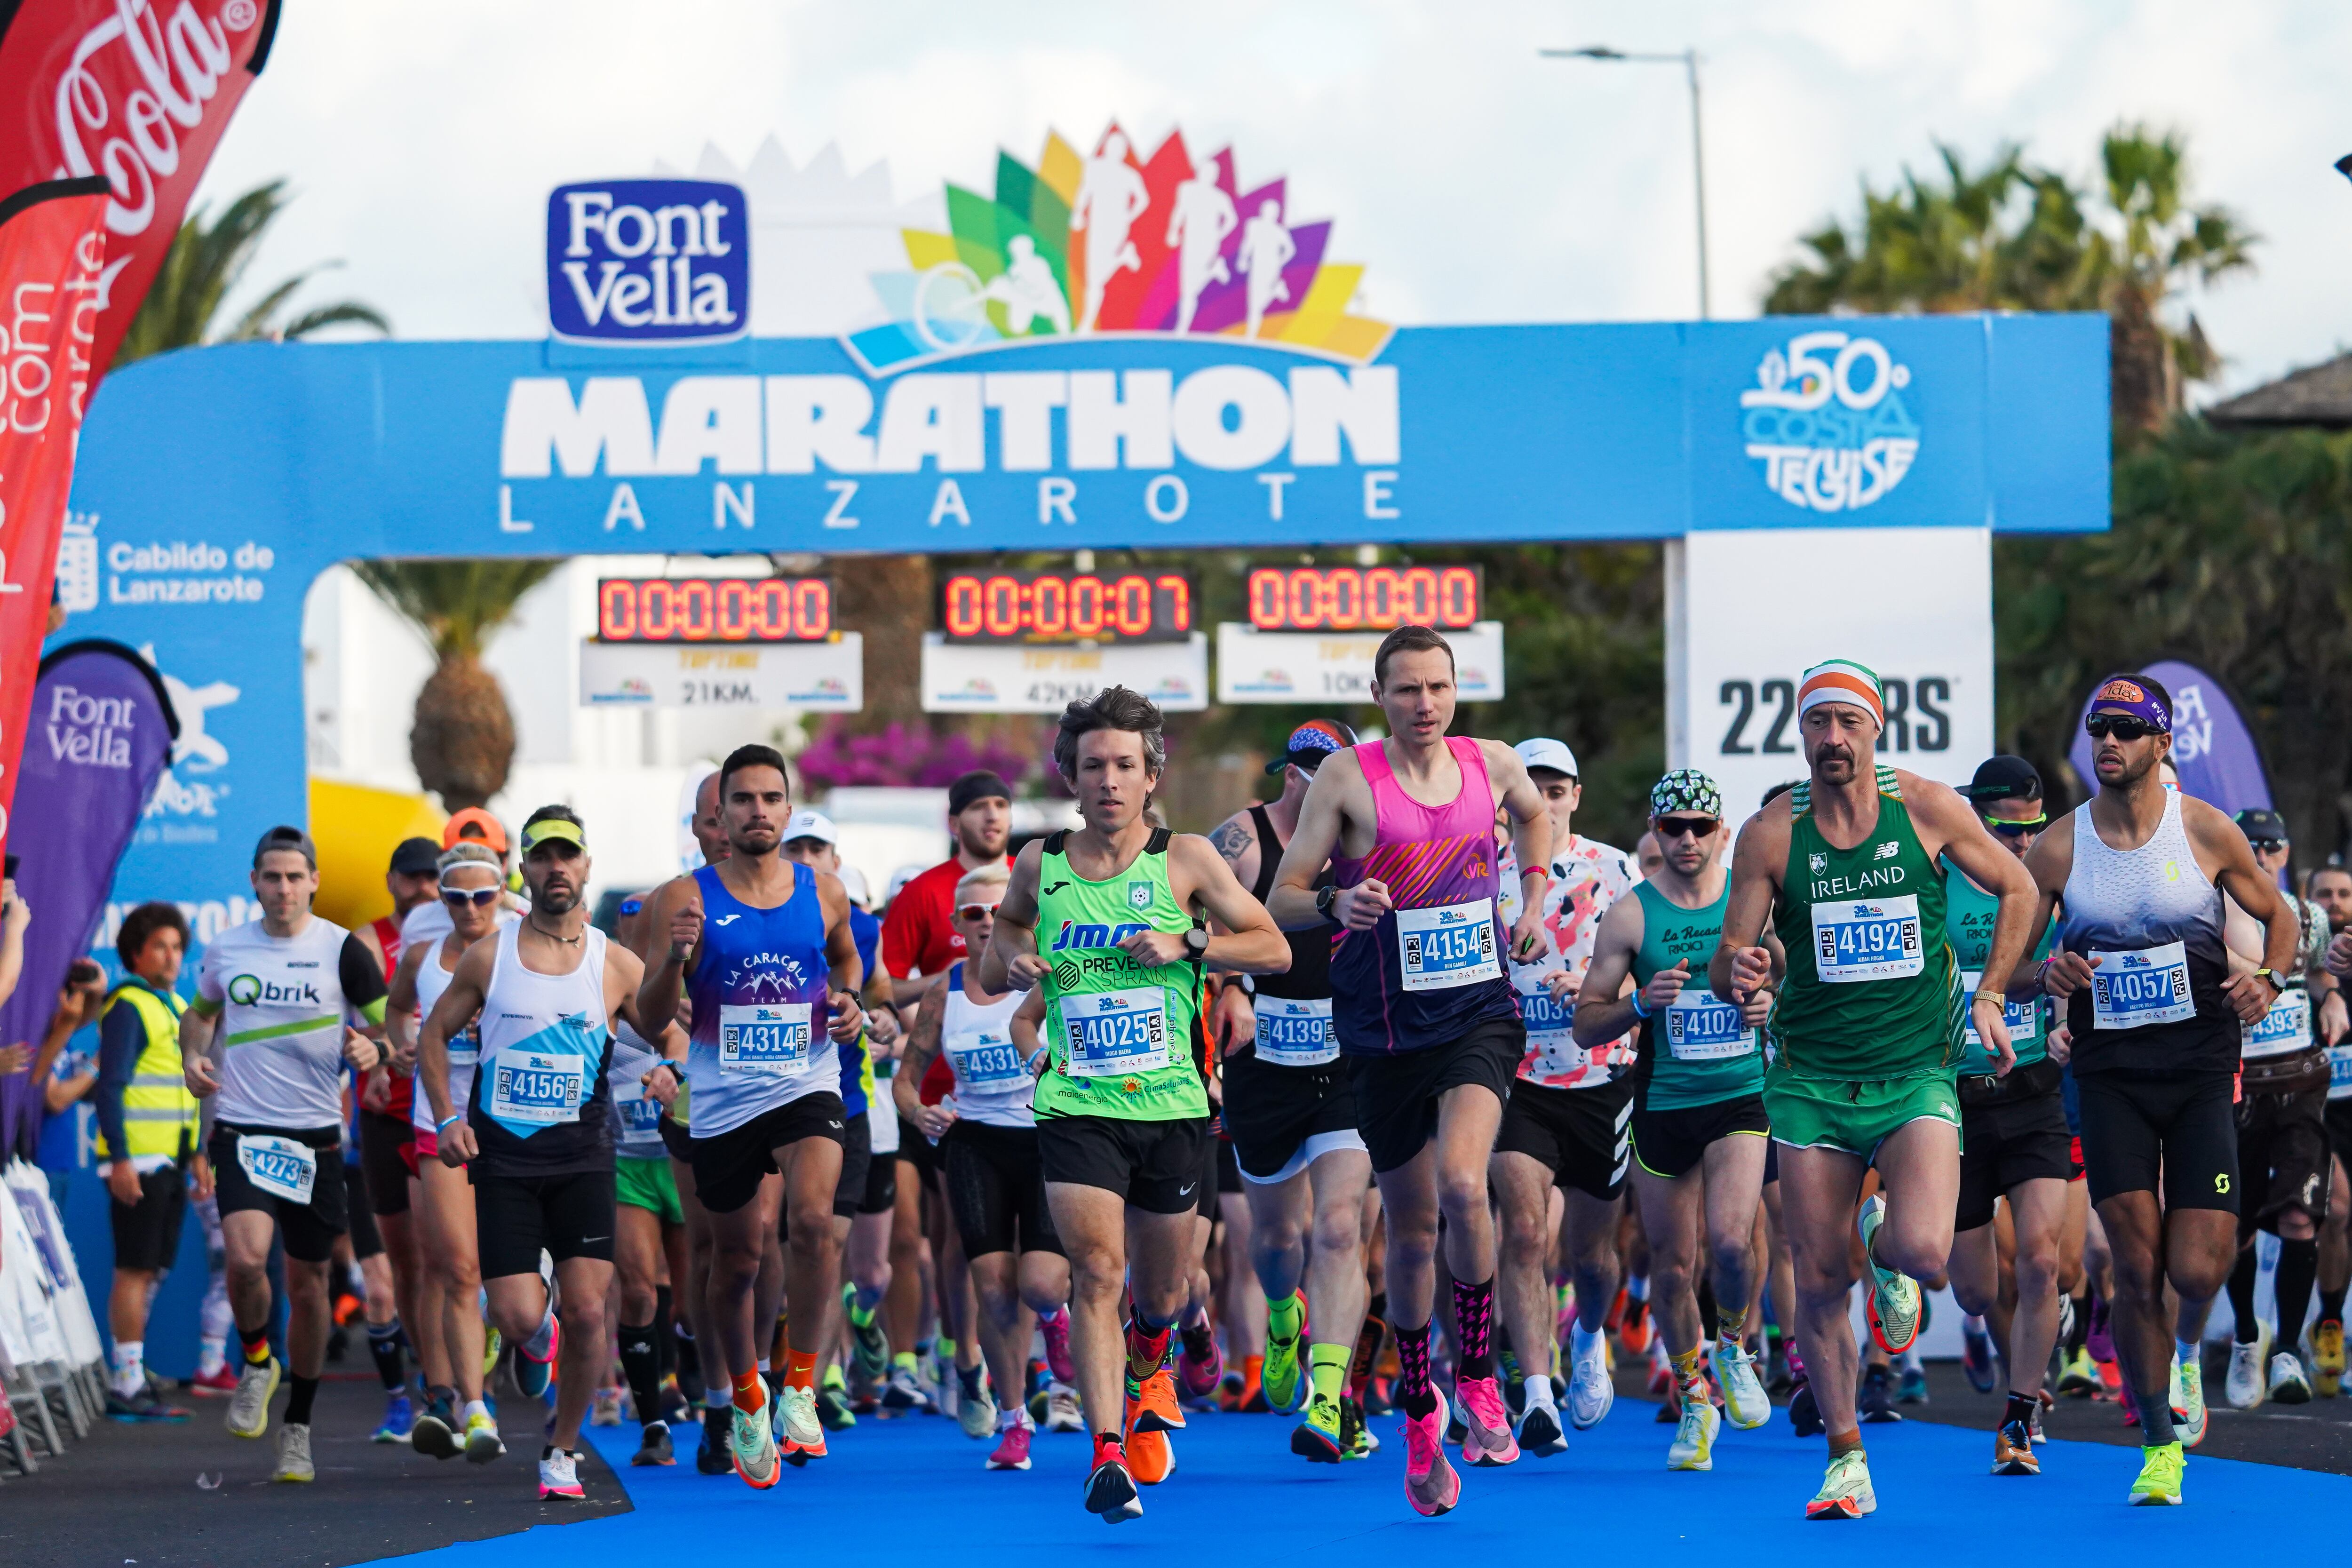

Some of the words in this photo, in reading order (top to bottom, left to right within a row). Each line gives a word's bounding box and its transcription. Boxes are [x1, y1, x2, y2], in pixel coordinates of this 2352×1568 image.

[56, 0, 230, 235] Cola
[564, 191, 731, 258] Font
[561, 257, 738, 326] Vella
[501, 365, 1400, 477] MARATHON
[1744, 392, 1920, 447] COSTA
[1746, 438, 1919, 512] TEGUISE
[500, 471, 1400, 532] LANZAROTE
[108, 541, 228, 571] Cabildo
[234, 541, 275, 570] de
[109, 575, 264, 604] Lanzarote
[946, 575, 1189, 636] 00:00:07
[1249, 567, 1477, 629] 00:00:00
[600, 579, 829, 639] 00:00:00
[49, 685, 135, 729] Font
[46, 722, 132, 768] Vella
[1812, 867, 1905, 899] IRELAND
[1424, 926, 1480, 961] 4154
[1839, 923, 1900, 954] 4192
[229, 973, 321, 1008] Qbrik
[725, 970, 741, 987] LA
[1101, 968, 1167, 987] SPRAIN
[2112, 969, 2169, 1002] 4057
[741, 1026, 796, 1052] 4314
[1086, 1013, 1149, 1049] 4025
[1272, 1019, 1323, 1043] 4139
[1687, 1008, 1738, 1035] 4102
[970, 1046, 1018, 1073] 4331
[513, 1072, 565, 1098] 4156
[1058, 1090, 1108, 1104] maiaenergia
[256, 1153, 300, 1181] 4273
